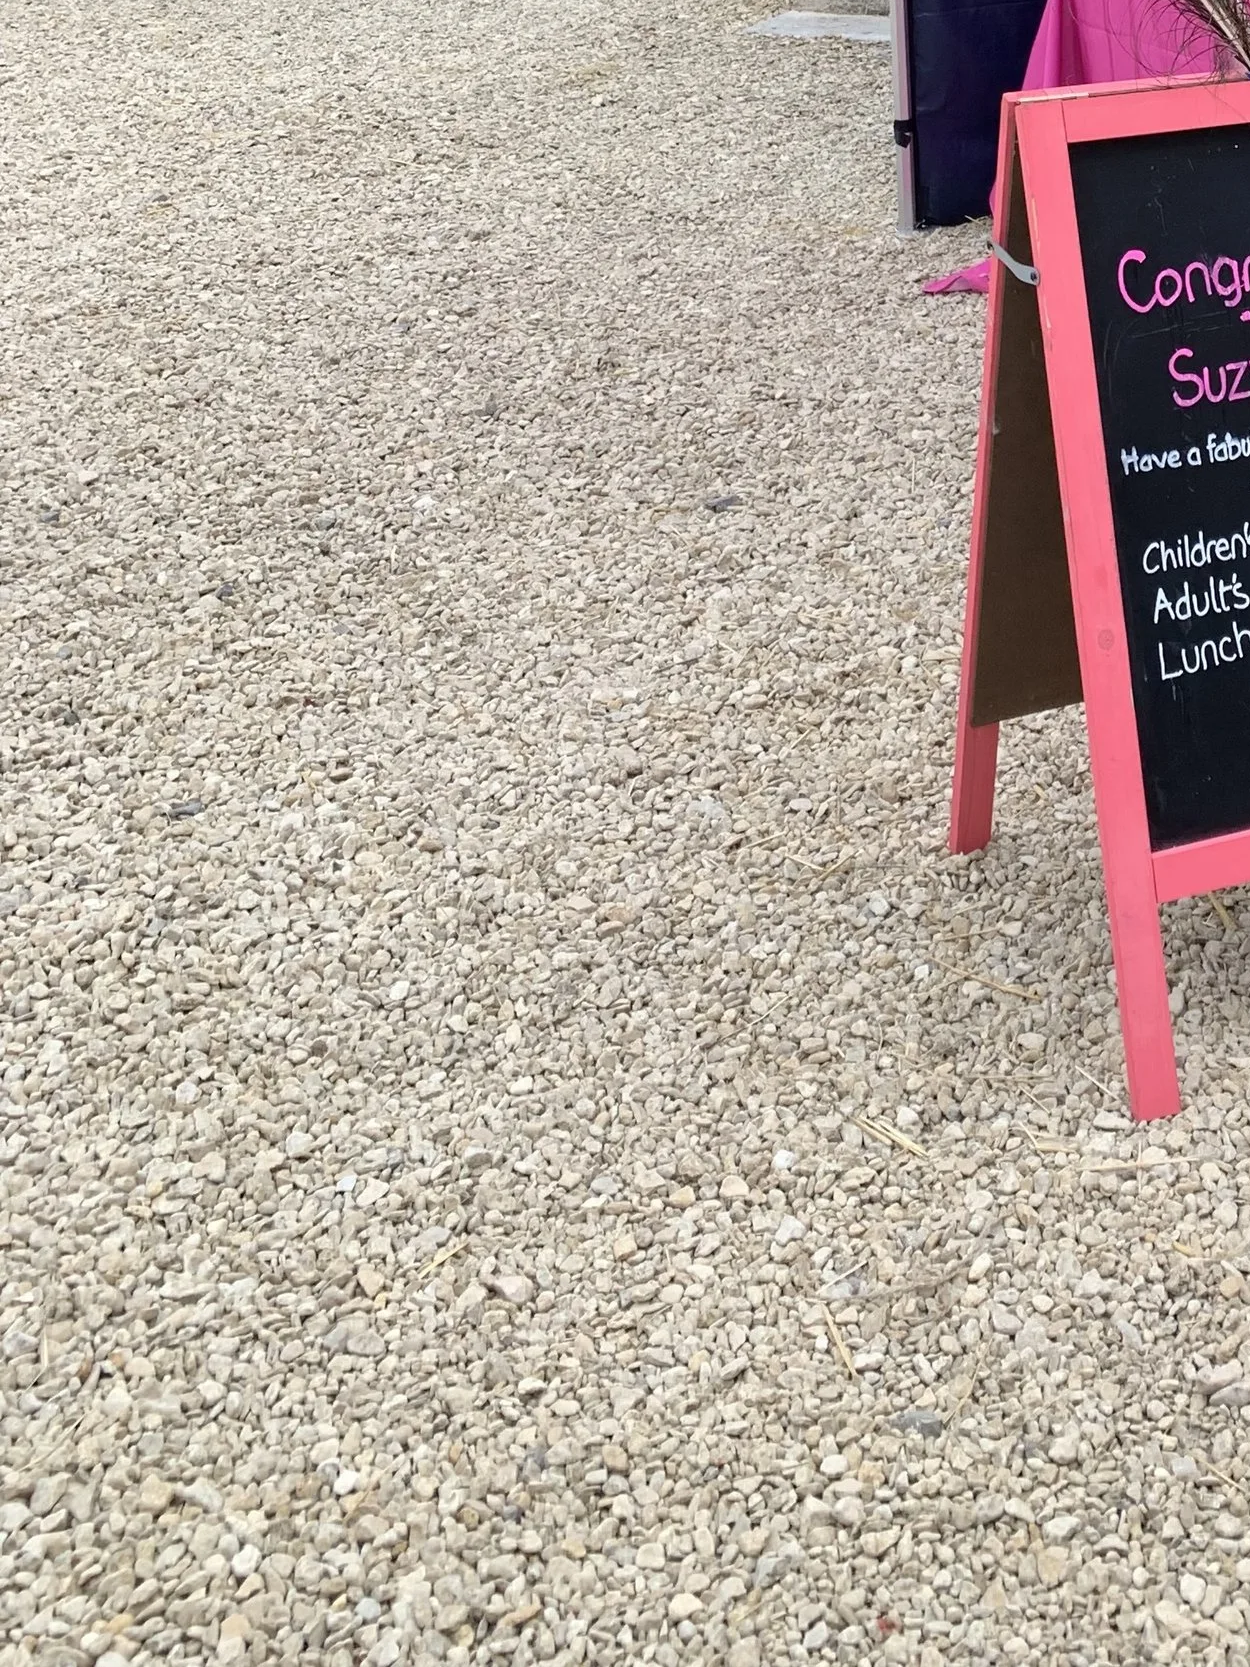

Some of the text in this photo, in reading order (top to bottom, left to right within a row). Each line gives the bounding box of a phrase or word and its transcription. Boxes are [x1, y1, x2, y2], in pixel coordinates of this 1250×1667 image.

[1120, 445, 1179, 475] Have
[1187, 446, 1202, 465] a
[1153, 573, 1250, 623] Adult's
